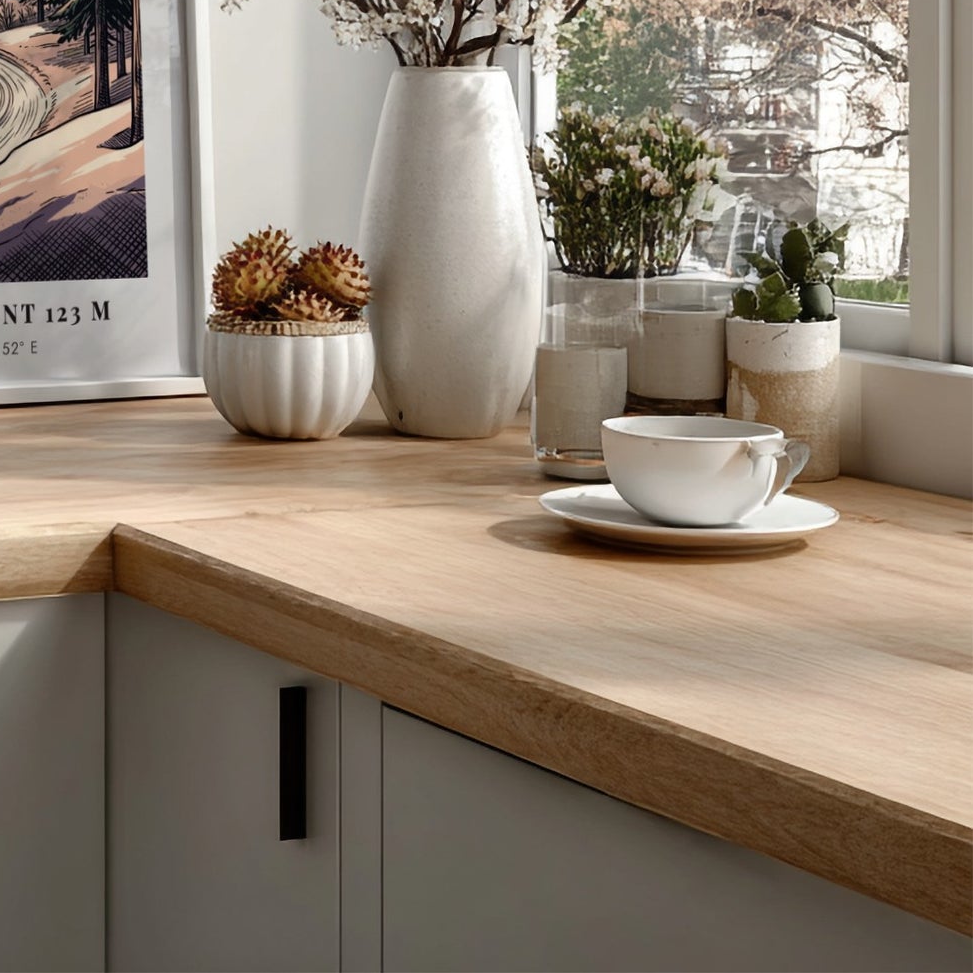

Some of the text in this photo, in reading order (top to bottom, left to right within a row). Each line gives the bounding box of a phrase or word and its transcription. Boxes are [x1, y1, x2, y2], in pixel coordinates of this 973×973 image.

[46, 306, 81, 326] 123
[91, 300, 110, 322] M
[30, 340, 38, 355] E
